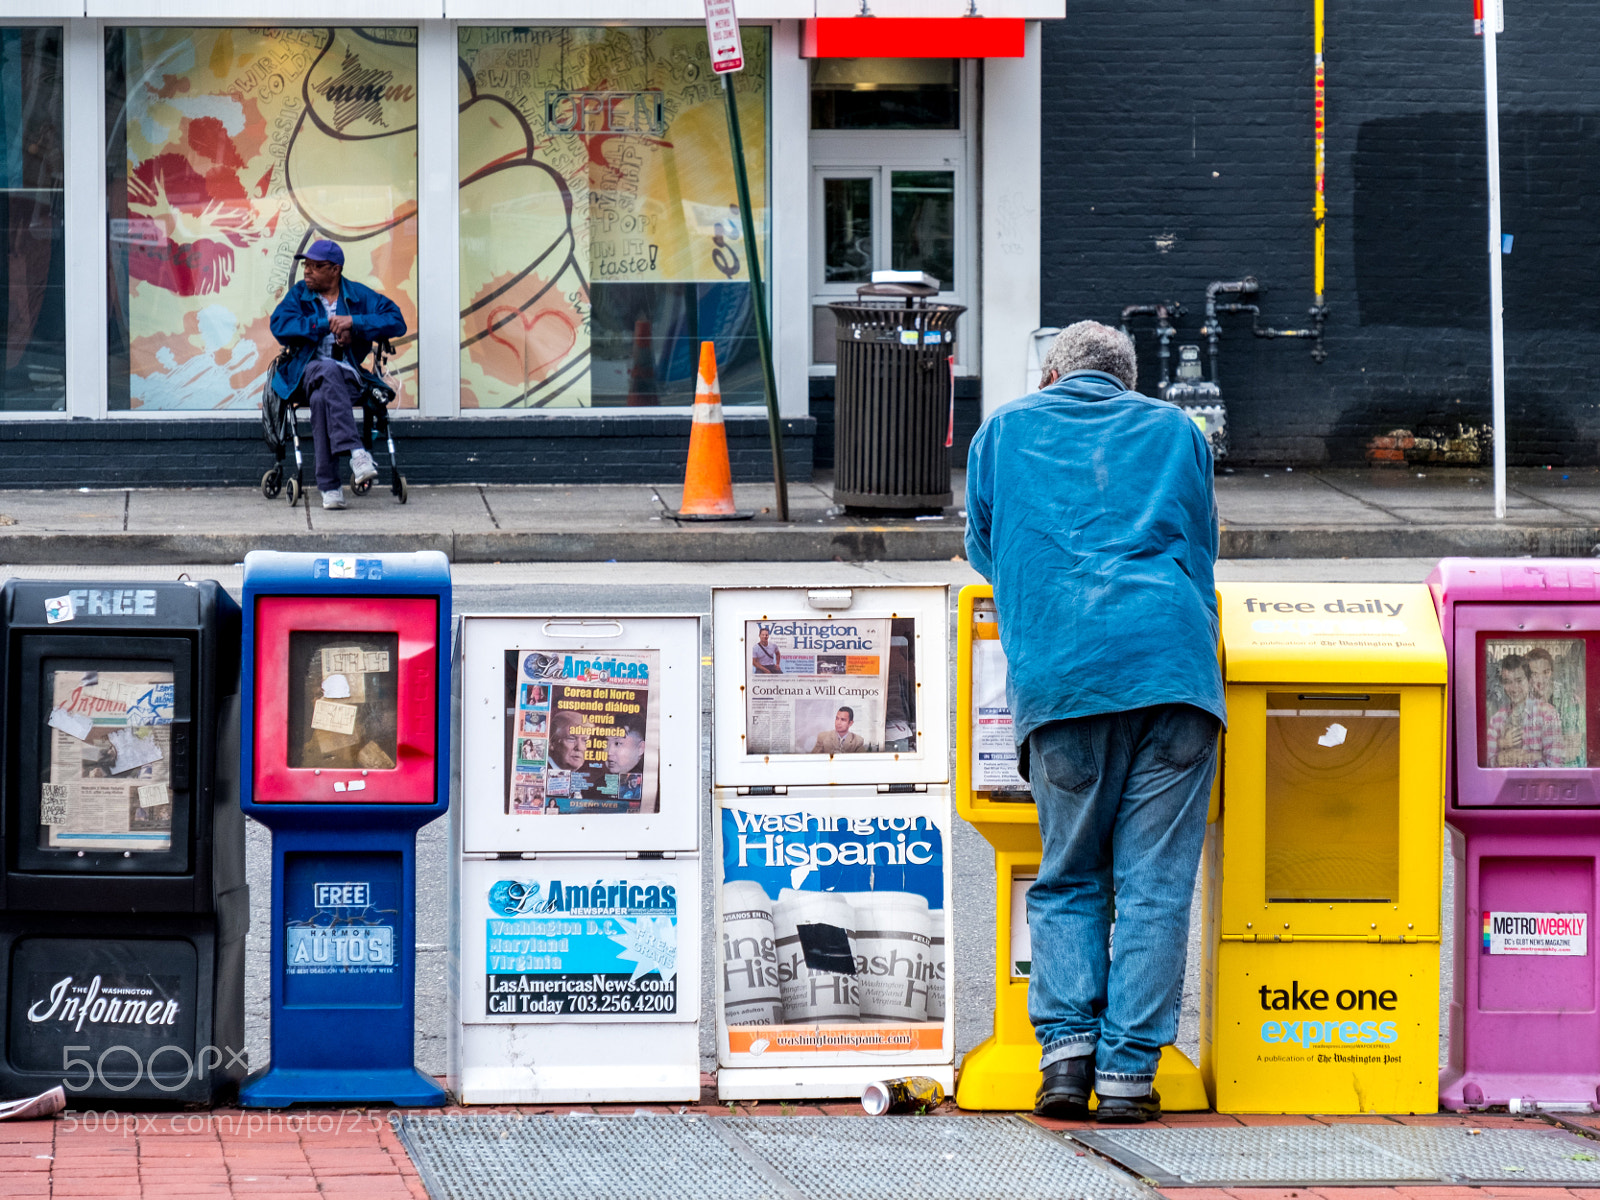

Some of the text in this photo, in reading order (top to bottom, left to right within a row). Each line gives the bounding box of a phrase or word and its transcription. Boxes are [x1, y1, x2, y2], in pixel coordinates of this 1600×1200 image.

[552, 94, 658, 130] OPEN
[600, 244, 658, 276] taste!
[69, 589, 156, 615] FREE
[1244, 598, 1403, 617] free daily
[757, 622, 857, 638] Washington
[793, 636, 873, 652] Hispanic
[564, 686, 635, 700] Corea del Norte
[752, 685, 879, 699] Condenan a Will Campos
[558, 700, 640, 713] suspende diálogo
[582, 715, 589, 724] y
[569, 725, 625, 737] advertencia
[586, 737, 608, 749] a los
[730, 809, 934, 836] Washington
[738, 833, 933, 871] Hispanic
[319, 886, 365, 904] FREE
[504, 879, 677, 914] Las Américas
[570, 907, 628, 915] NEWSPAPER
[490, 920, 618, 937] Washington D.C.
[294, 938, 383, 962] AUTOS
[489, 938, 569, 954] Maryland
[635, 929, 677, 958] FREE
[1530, 938, 1544, 946] NEWS
[1545, 938, 1571, 946] MAGAZINE
[489, 955, 562, 971] Virginia
[489, 974, 675, 992] LasAmericasNews.com
[809, 975, 859, 1007] His
[27, 974, 180, 1033] Informer
[489, 994, 674, 1014] Call Today 703.256.4200
[1258, 980, 1398, 1011] take one
[776, 1033, 911, 1047] washingtonhispanic.com
[1260, 1020, 1399, 1049] express
[1317, 1054, 1332, 1063] The
[1334, 1053, 1381, 1065] Washington
[1383, 1054, 1401, 1065] Post
